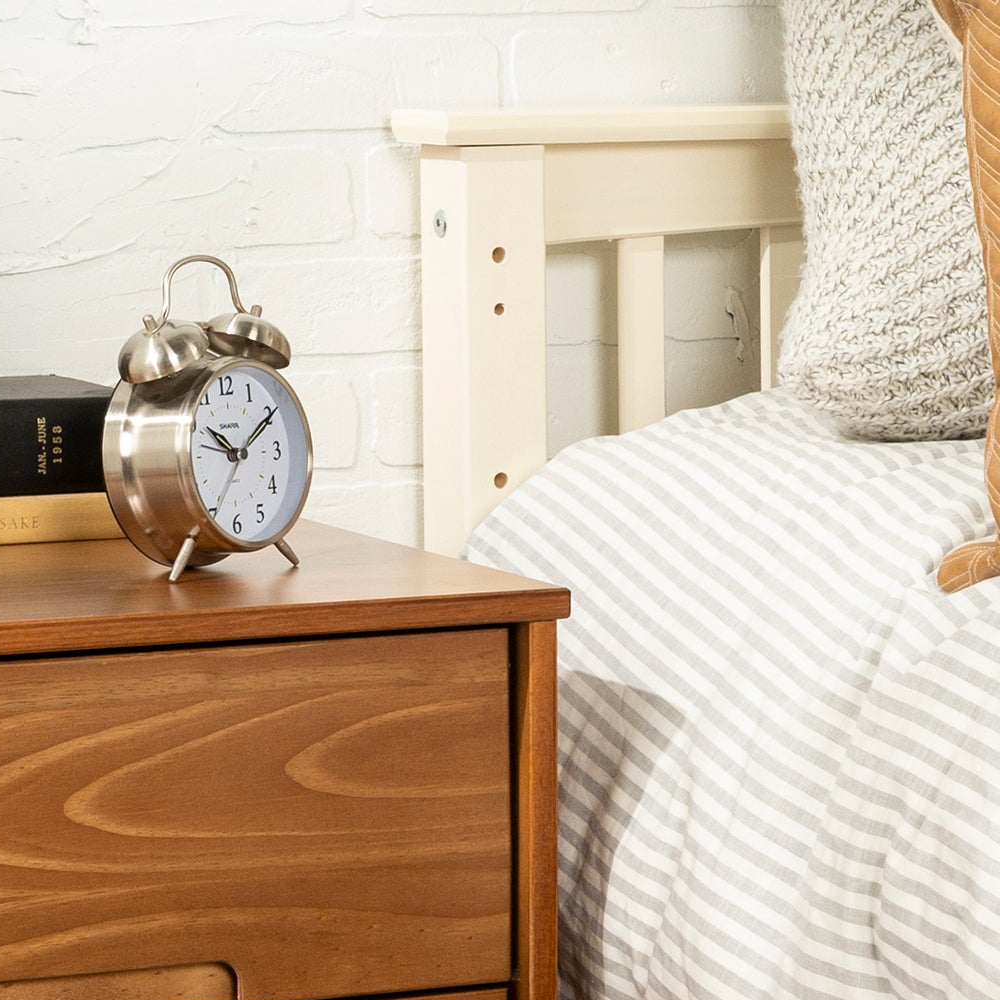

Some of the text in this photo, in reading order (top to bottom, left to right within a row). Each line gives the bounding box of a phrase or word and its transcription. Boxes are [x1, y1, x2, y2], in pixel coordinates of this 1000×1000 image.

[217, 375, 234, 396] 12
[246, 383, 253, 403] 1
[52, 425, 62, 463] 1958
[272, 441, 282, 461] 3
[268, 475, 278, 494] 4
[256, 503, 265, 523] 5
[232, 513, 242, 534] 6
